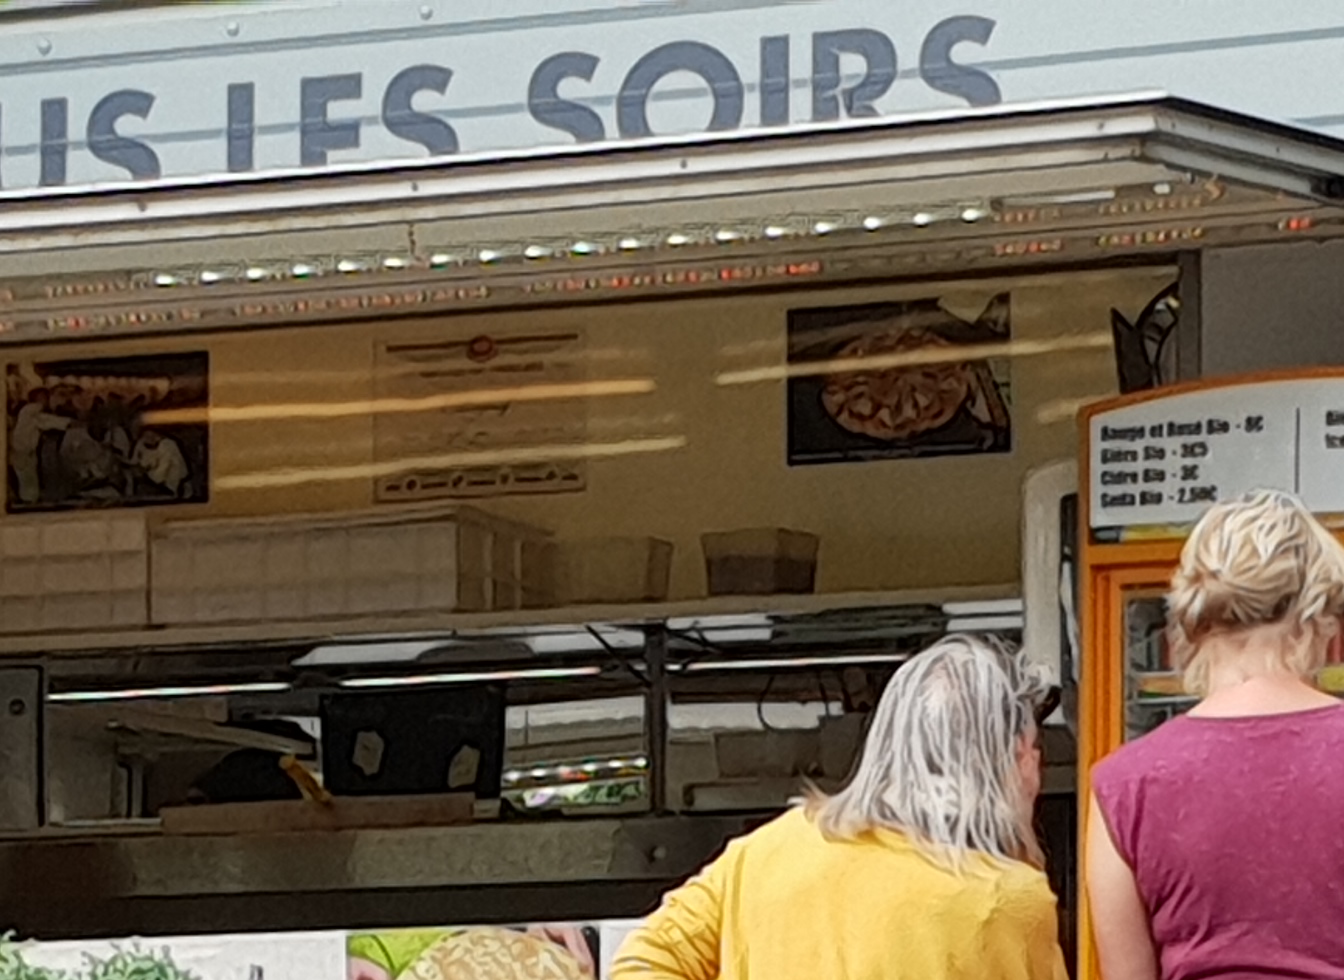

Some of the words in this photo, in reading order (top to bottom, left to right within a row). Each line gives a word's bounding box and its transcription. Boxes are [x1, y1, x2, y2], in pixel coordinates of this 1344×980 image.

[226, 63, 458, 175] LES
[525, 14, 1002, 142] SOIRS
[1149, 424, 1164, 438] et
[1207, 418, 1230, 435] Bio
[1143, 445, 1166, 461] Bio
[1142, 467, 1166, 483] Bio
[1139, 490, 1163, 506] Bio
